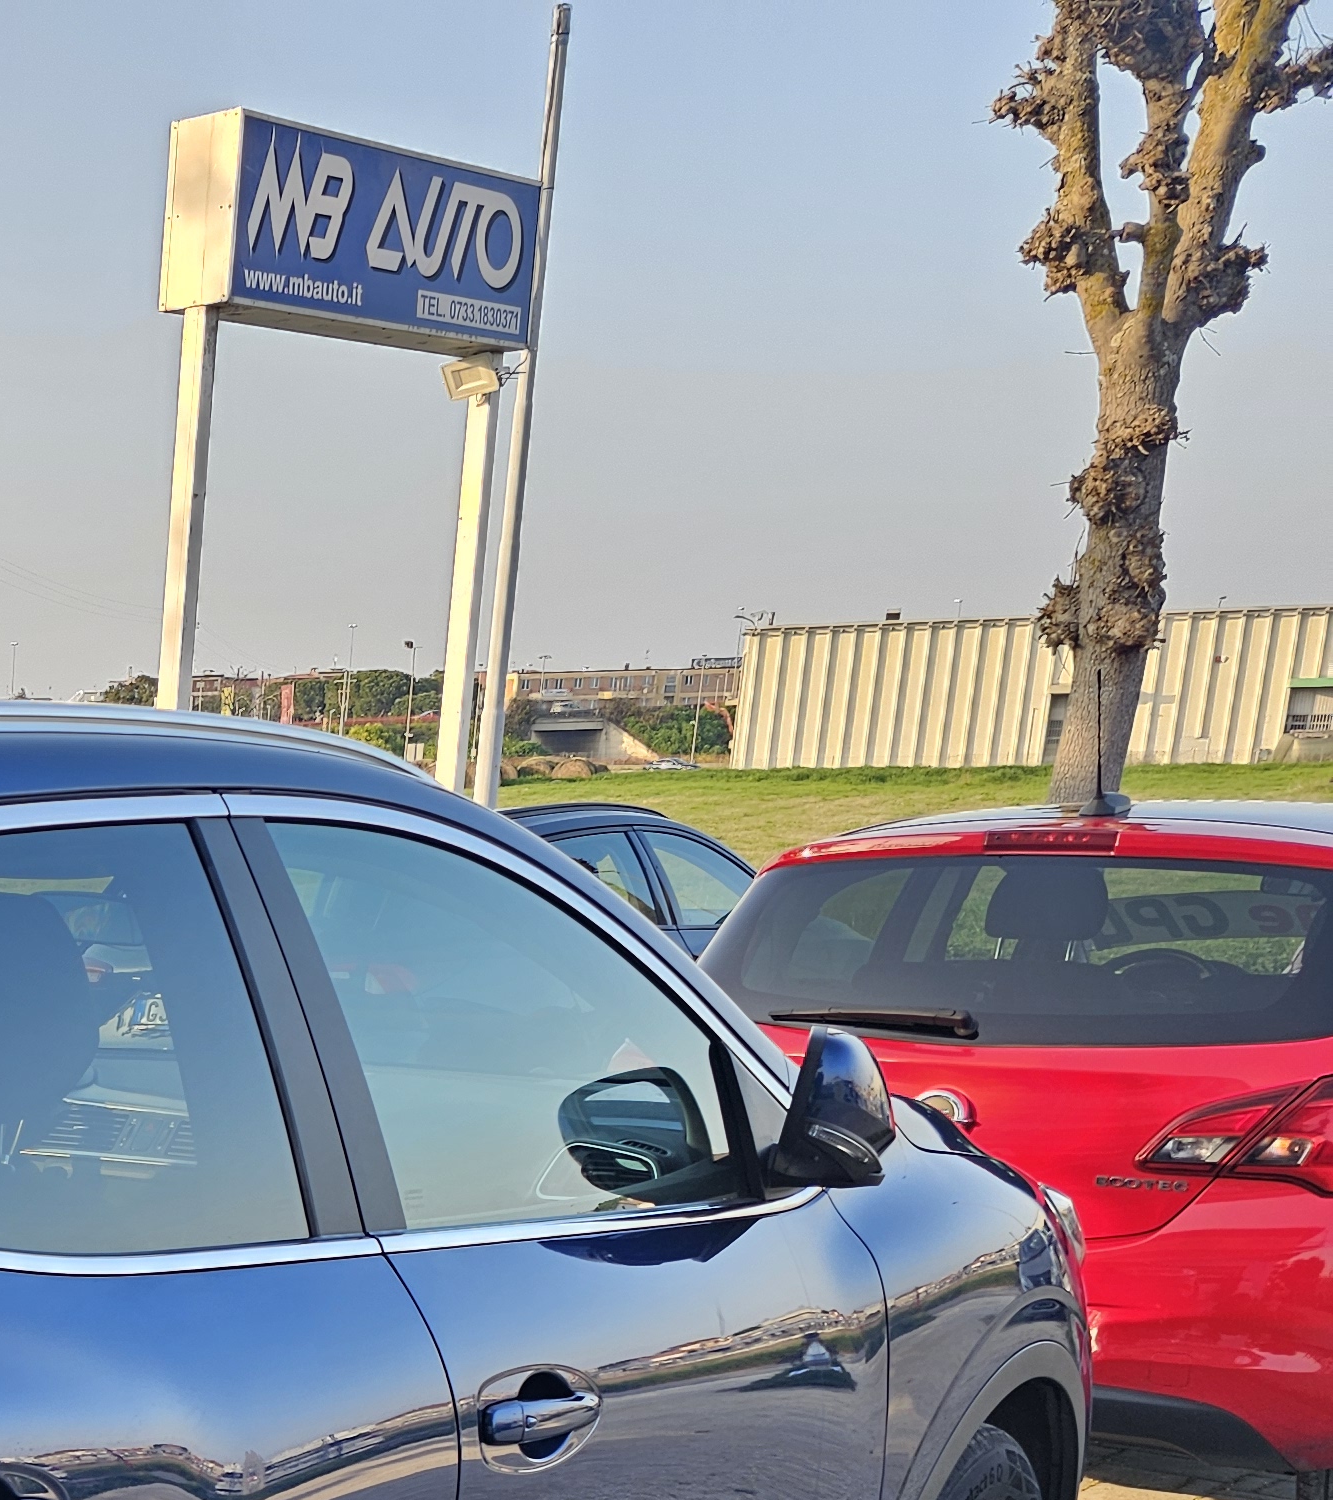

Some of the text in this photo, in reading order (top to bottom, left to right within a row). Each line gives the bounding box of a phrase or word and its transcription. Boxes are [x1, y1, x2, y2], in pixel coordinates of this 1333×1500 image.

[247, 126, 523, 289] MB AUTO
[243, 266, 362, 306] www.mbauto.it
[420, 294, 520, 331] TEL. 0733.1830371
[1095, 1175, 1189, 1193] ECOTEC
